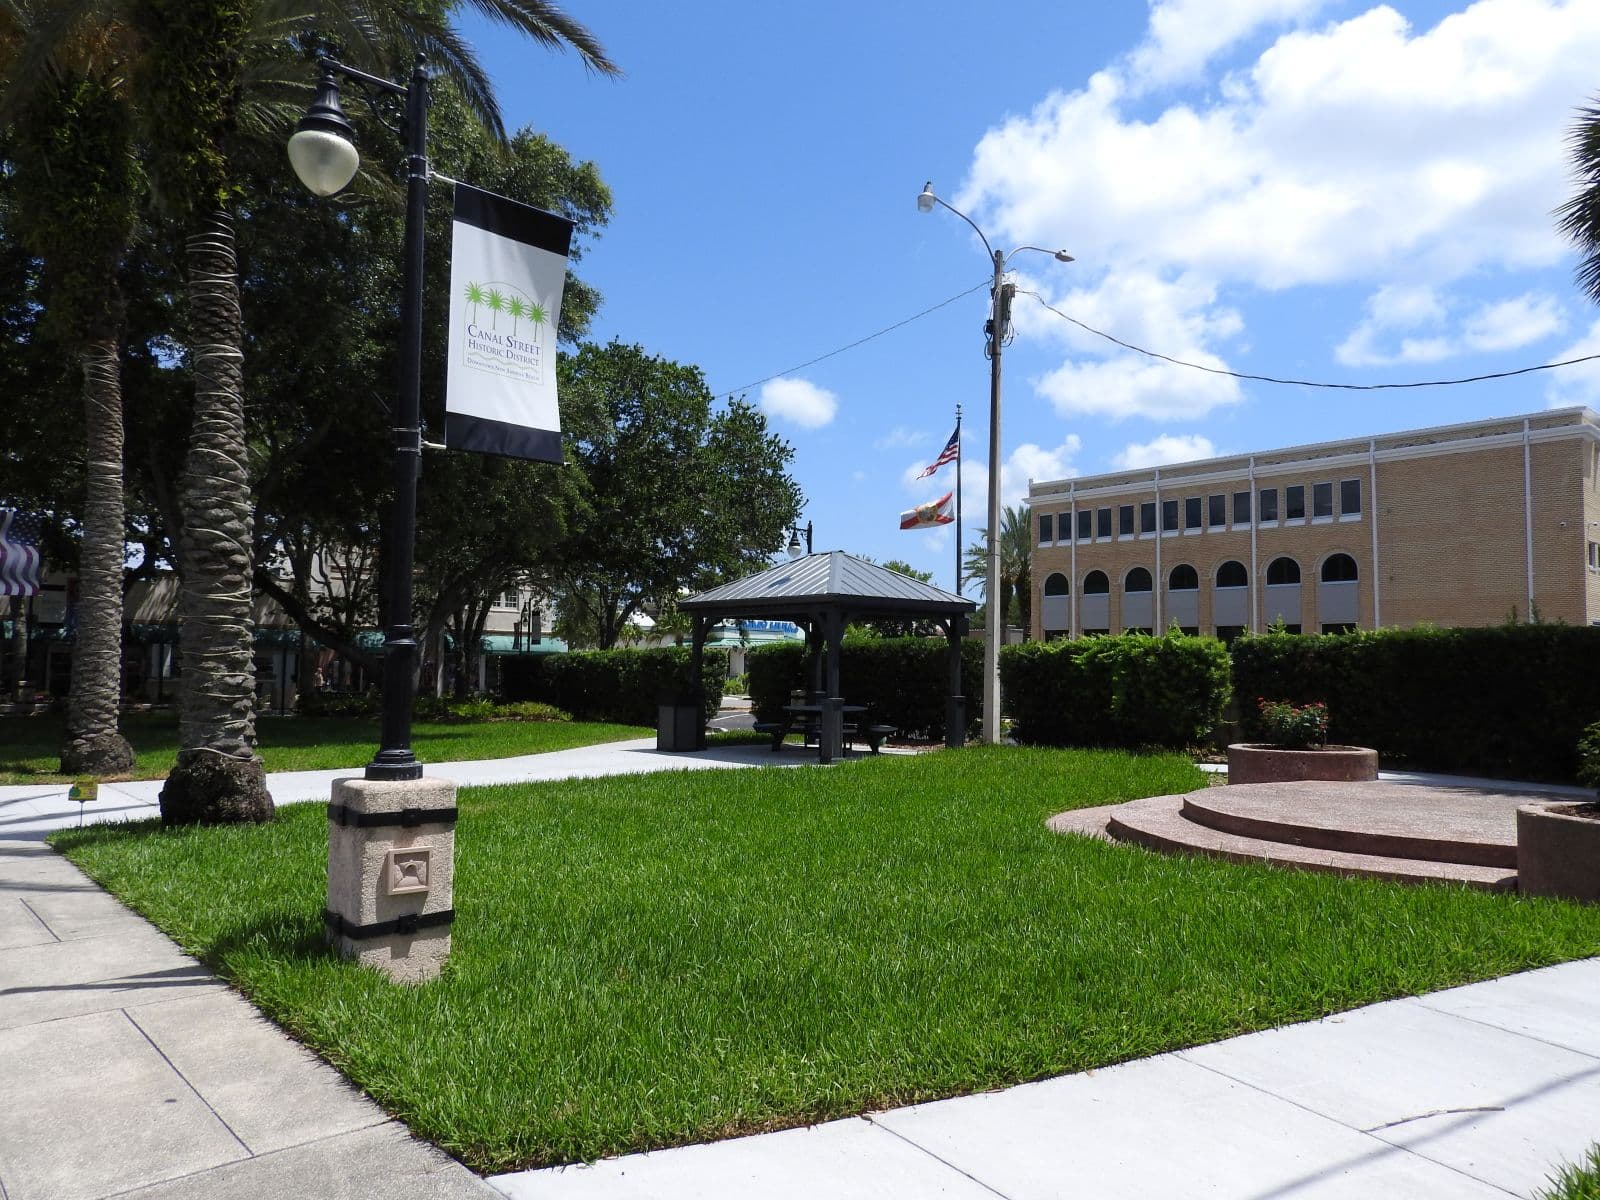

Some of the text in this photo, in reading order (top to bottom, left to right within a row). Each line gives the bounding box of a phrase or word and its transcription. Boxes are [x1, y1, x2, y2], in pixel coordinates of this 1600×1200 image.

[467, 324, 540, 356] CANAL STREET
[468, 339, 540, 367] HISTORIC DISTRICT
